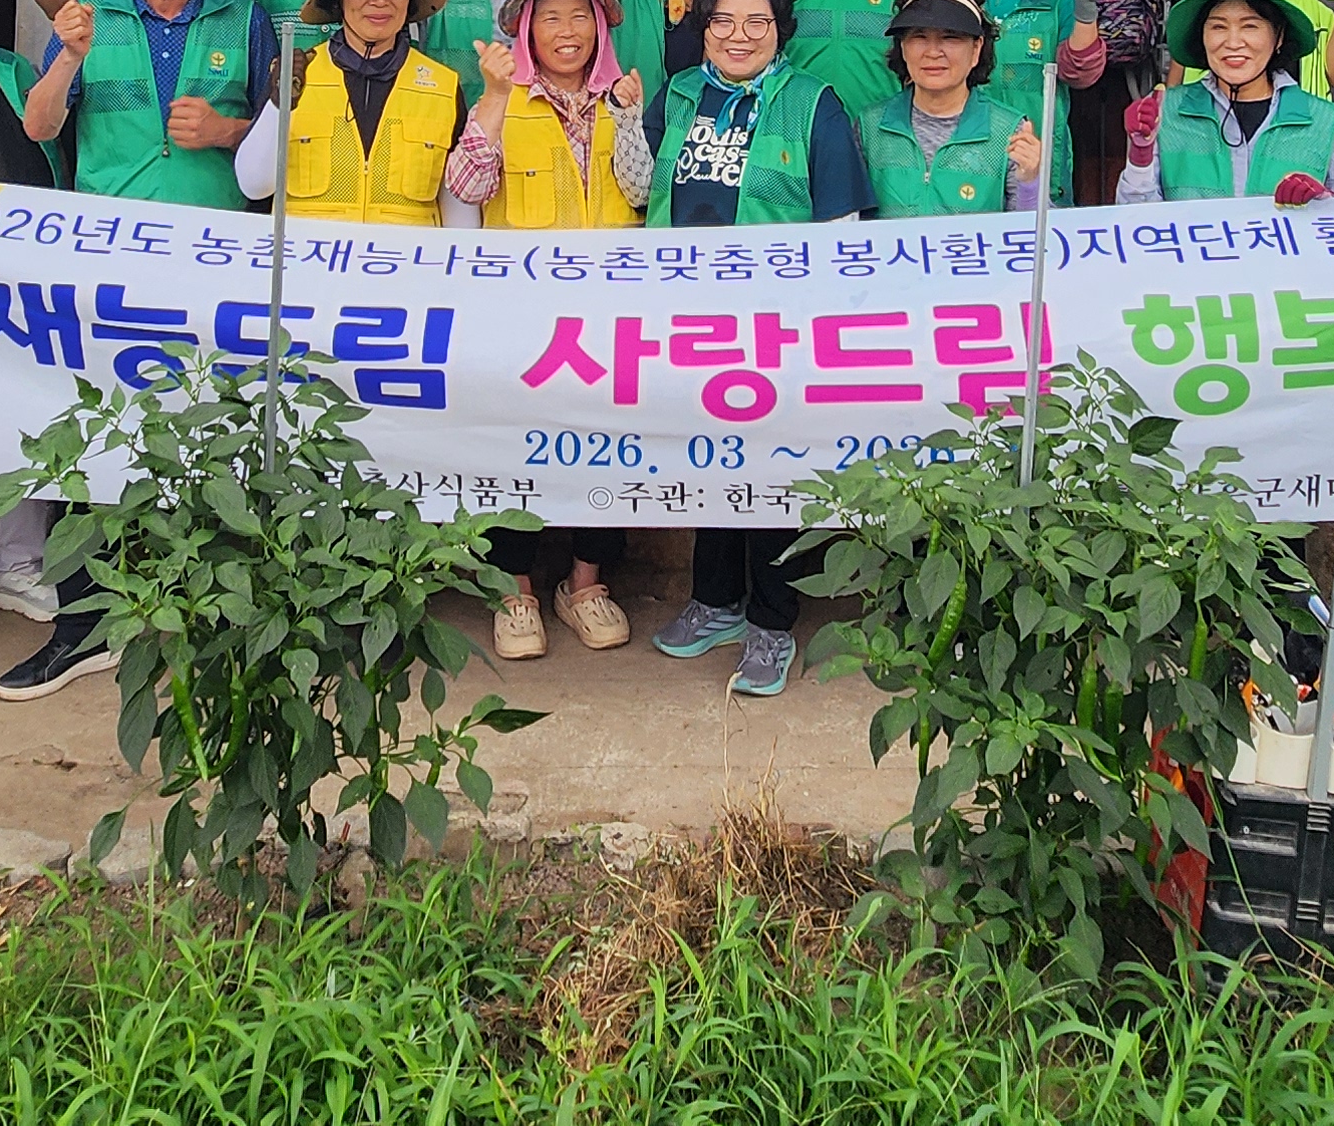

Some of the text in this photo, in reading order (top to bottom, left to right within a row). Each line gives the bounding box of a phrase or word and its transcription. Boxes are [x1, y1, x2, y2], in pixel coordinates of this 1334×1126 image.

[831, 217, 1299, 277] 봉사활동)지역단체
[520, 302, 1053, 422] 사랑드림
[524, 431, 658, 474] 2026.
[687, 434, 746, 471] 03
